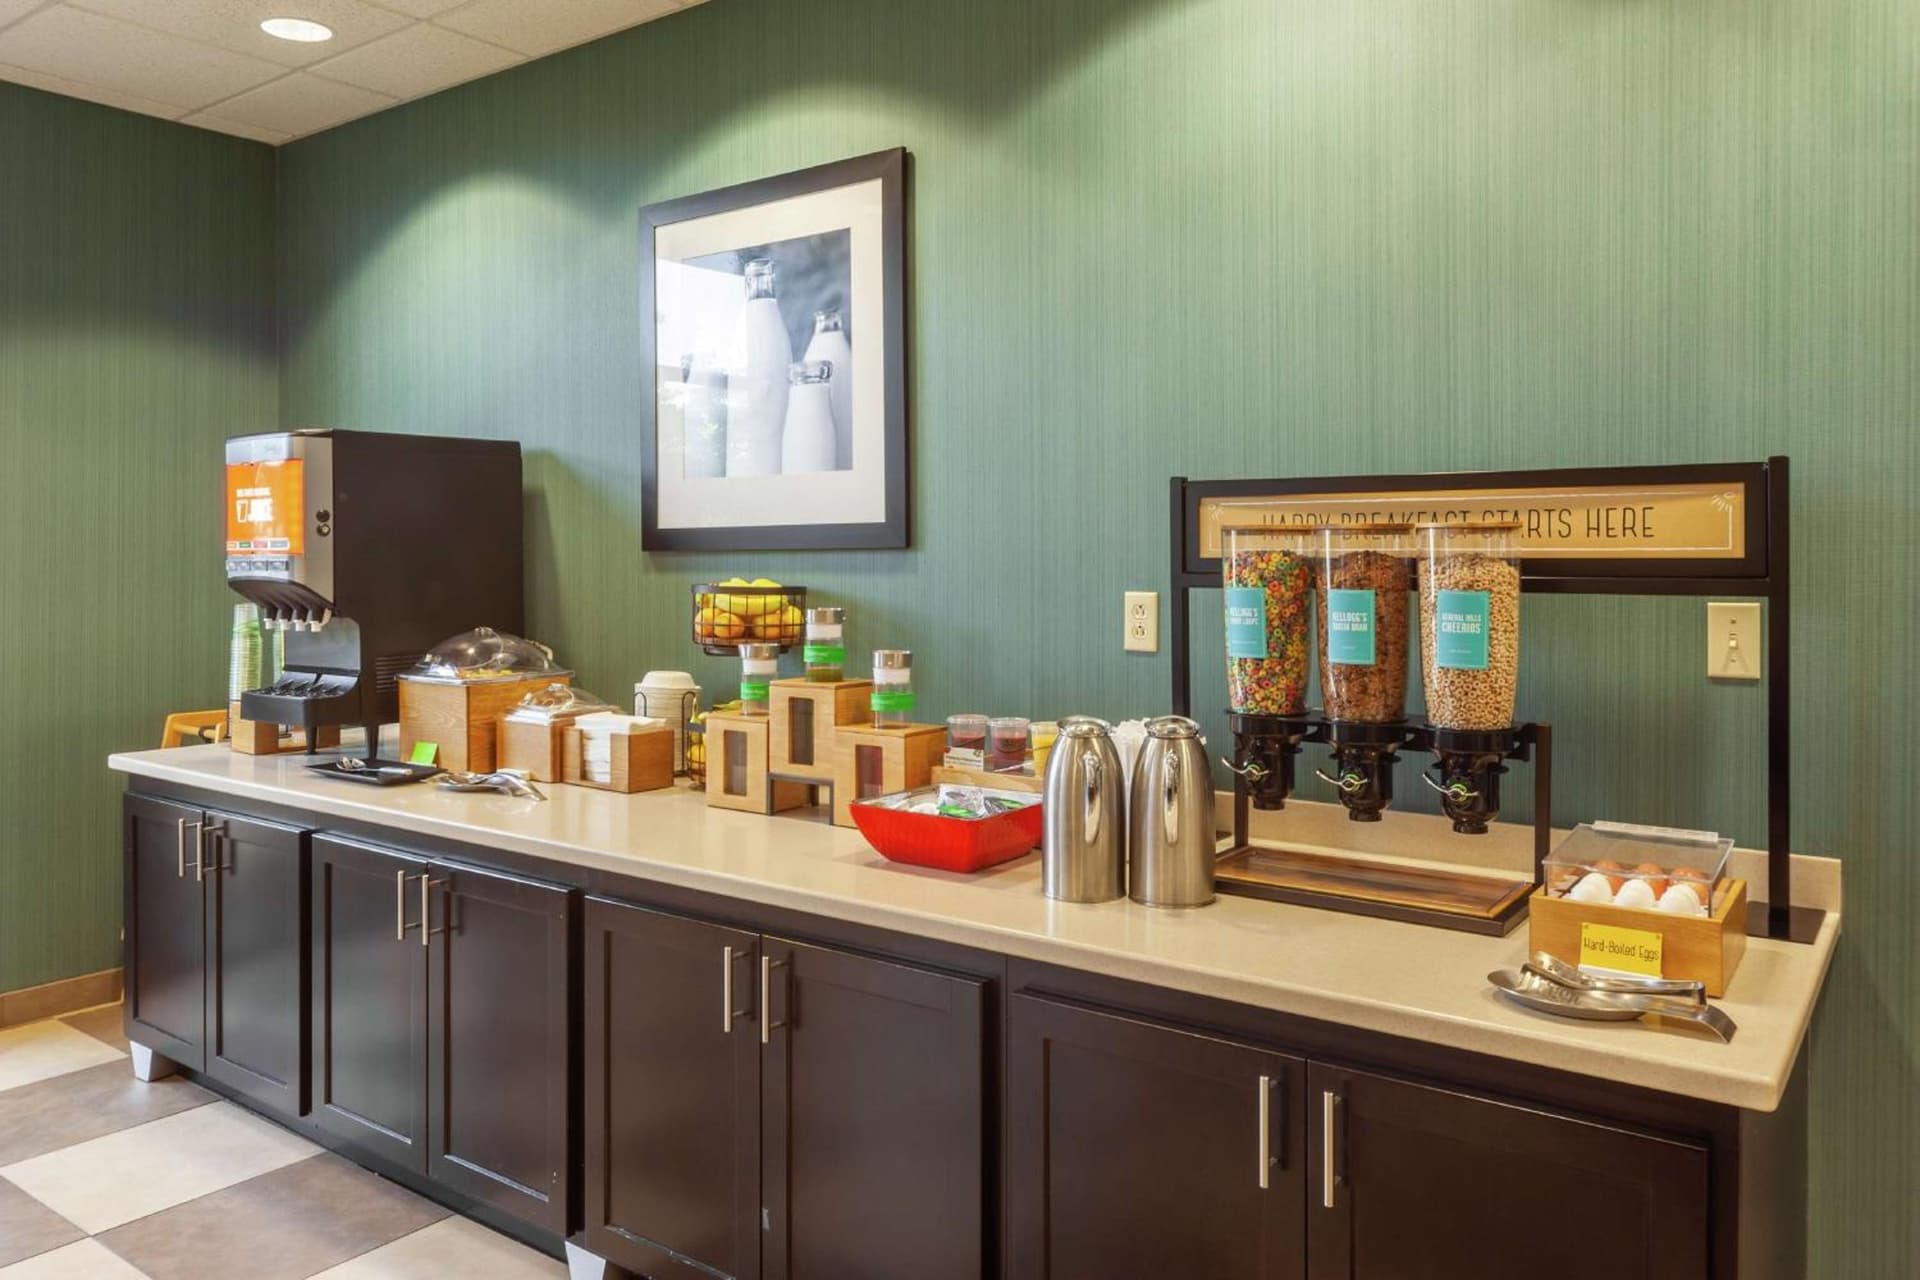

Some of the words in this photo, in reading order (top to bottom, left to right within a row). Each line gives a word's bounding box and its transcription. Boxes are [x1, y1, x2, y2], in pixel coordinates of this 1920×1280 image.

[1481, 508, 1572, 539] STARTS
[1586, 506, 1655, 538] HERE
[1442, 622, 1481, 634] CHEERIOS
[1584, 936, 1636, 957] Hard-Boiled
[1639, 945, 1660, 962] Eggs
